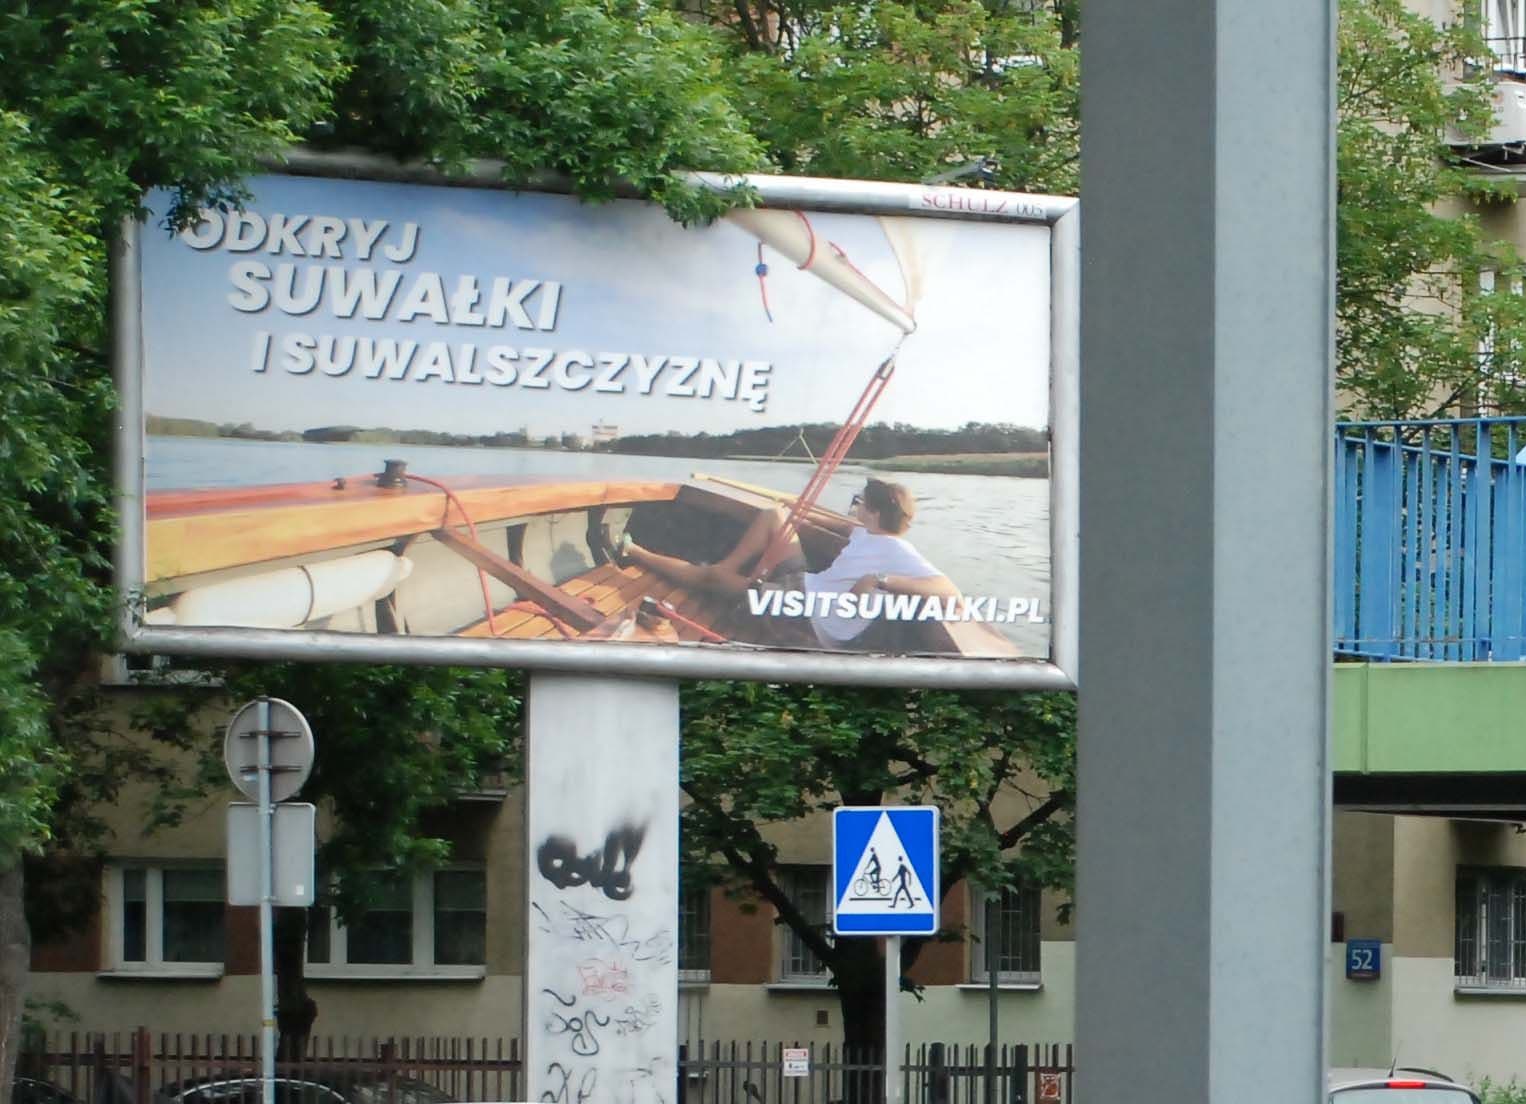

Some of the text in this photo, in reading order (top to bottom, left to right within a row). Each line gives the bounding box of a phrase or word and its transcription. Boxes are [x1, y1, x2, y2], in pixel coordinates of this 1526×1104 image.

[181, 208, 419, 263] ODKRYJ
[228, 261, 563, 332] SUWAŁKI
[250, 330, 773, 413] I SUWALSZCZYZNĘ
[747, 589, 1046, 624] VISITSUWALKI.PL
[1351, 949, 1373, 970] 52
